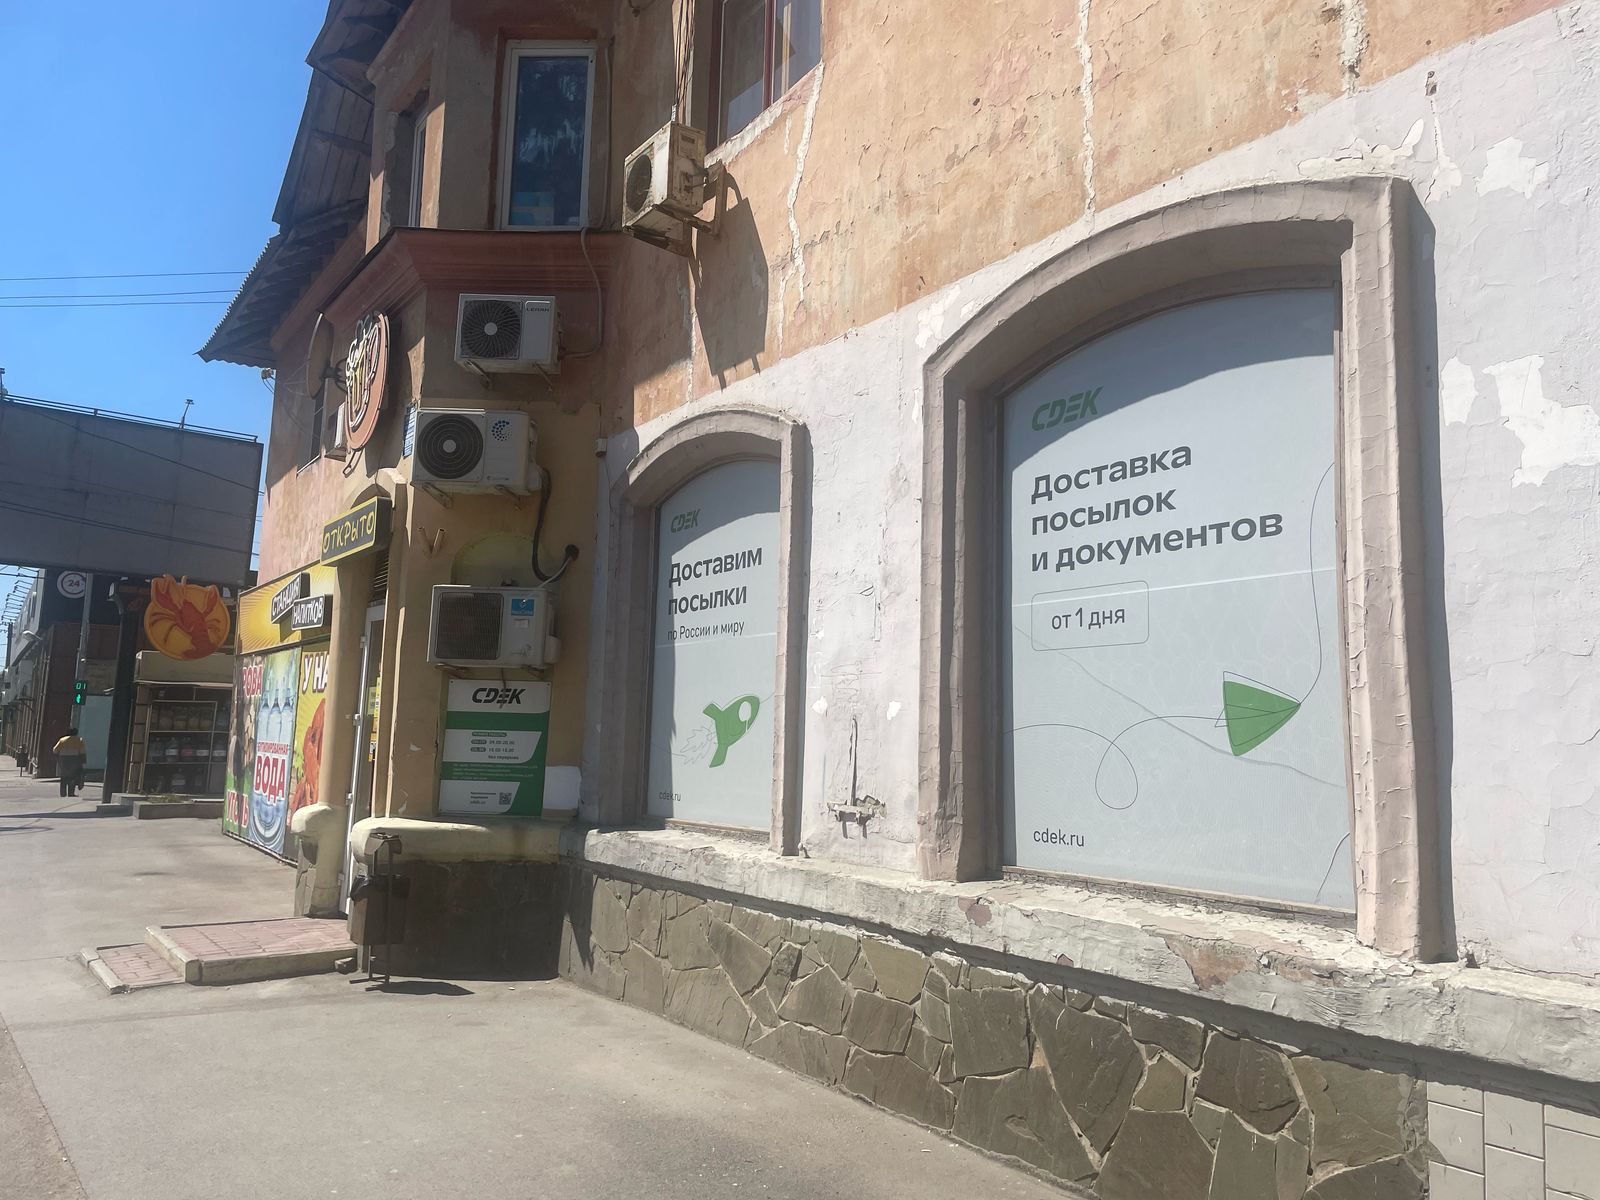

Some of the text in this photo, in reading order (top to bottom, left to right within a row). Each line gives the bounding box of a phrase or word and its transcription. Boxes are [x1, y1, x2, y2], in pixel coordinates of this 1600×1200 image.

[1031, 386, 1104, 431] CDEK
[1031, 445, 1192, 504] Доставка
[670, 508, 701, 533] CDEK
[1031, 488, 1177, 536] посылок
[322, 511, 375, 554] ОТКРЫТО
[1031, 513, 1283, 573] и документов
[68, 579, 80, 587] 24
[668, 547, 762, 588] Доставим
[272, 577, 300, 616] СТАНЦИЯ
[292, 597, 324, 625] НАПИТКОВ
[667, 585, 747, 615] посылки
[667, 621, 745, 641] по России и миру
[1051, 607, 1125, 630] от 1 дня
[302, 654, 314, 695] У
[471, 687, 526, 705] CDEK
[253, 755, 287, 807] ВОДА
[658, 792, 682, 801] cdek.ru
[226, 789, 250, 829] УГОЬ
[1033, 827, 1085, 847] cdek.ru
